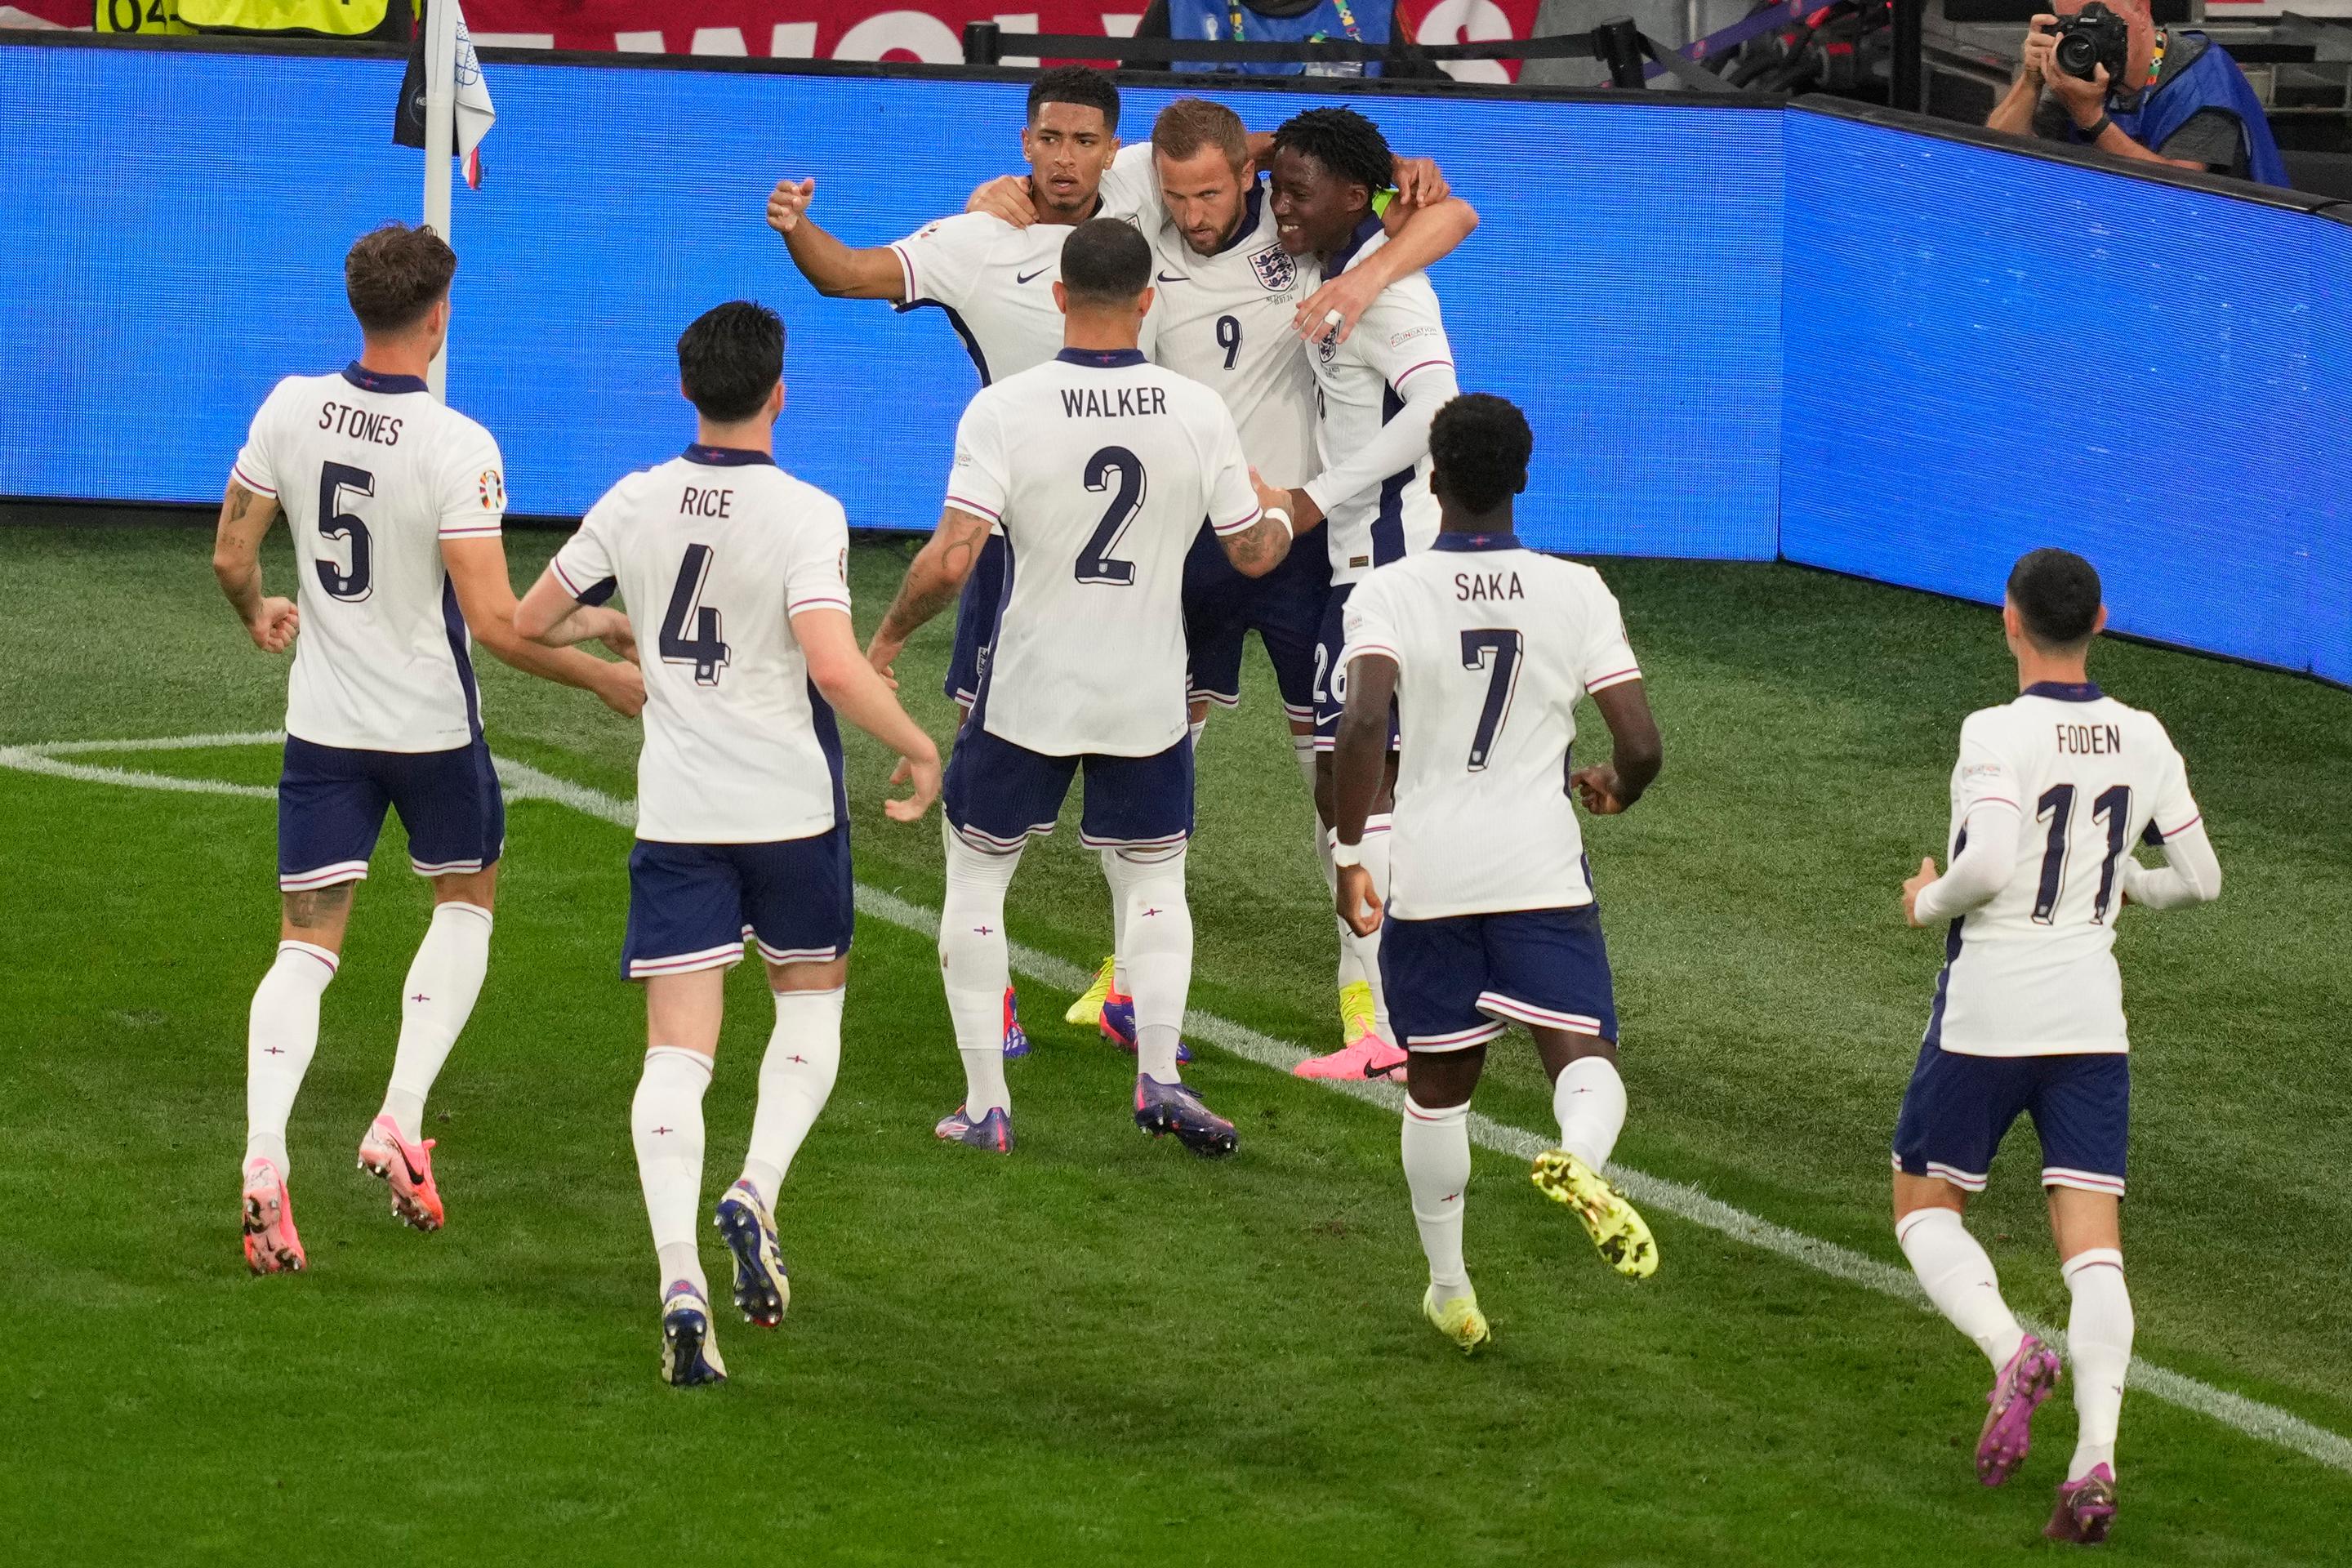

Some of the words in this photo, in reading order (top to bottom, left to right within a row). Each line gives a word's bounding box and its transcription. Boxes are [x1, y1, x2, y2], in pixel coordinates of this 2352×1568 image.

[1216, 315, 1243, 370] 9
[318, 401, 403, 446] STONES
[1061, 387, 1167, 418] WALKER
[679, 486, 734, 519] RICE
[1075, 445, 1147, 586] 2
[315, 460, 375, 603] 5
[1454, 572, 1525, 601] SAKA
[659, 543, 731, 687] 4
[1460, 629, 1524, 773] 7
[2056, 724, 2121, 755] FODEN
[2031, 783, 2133, 925] 11
